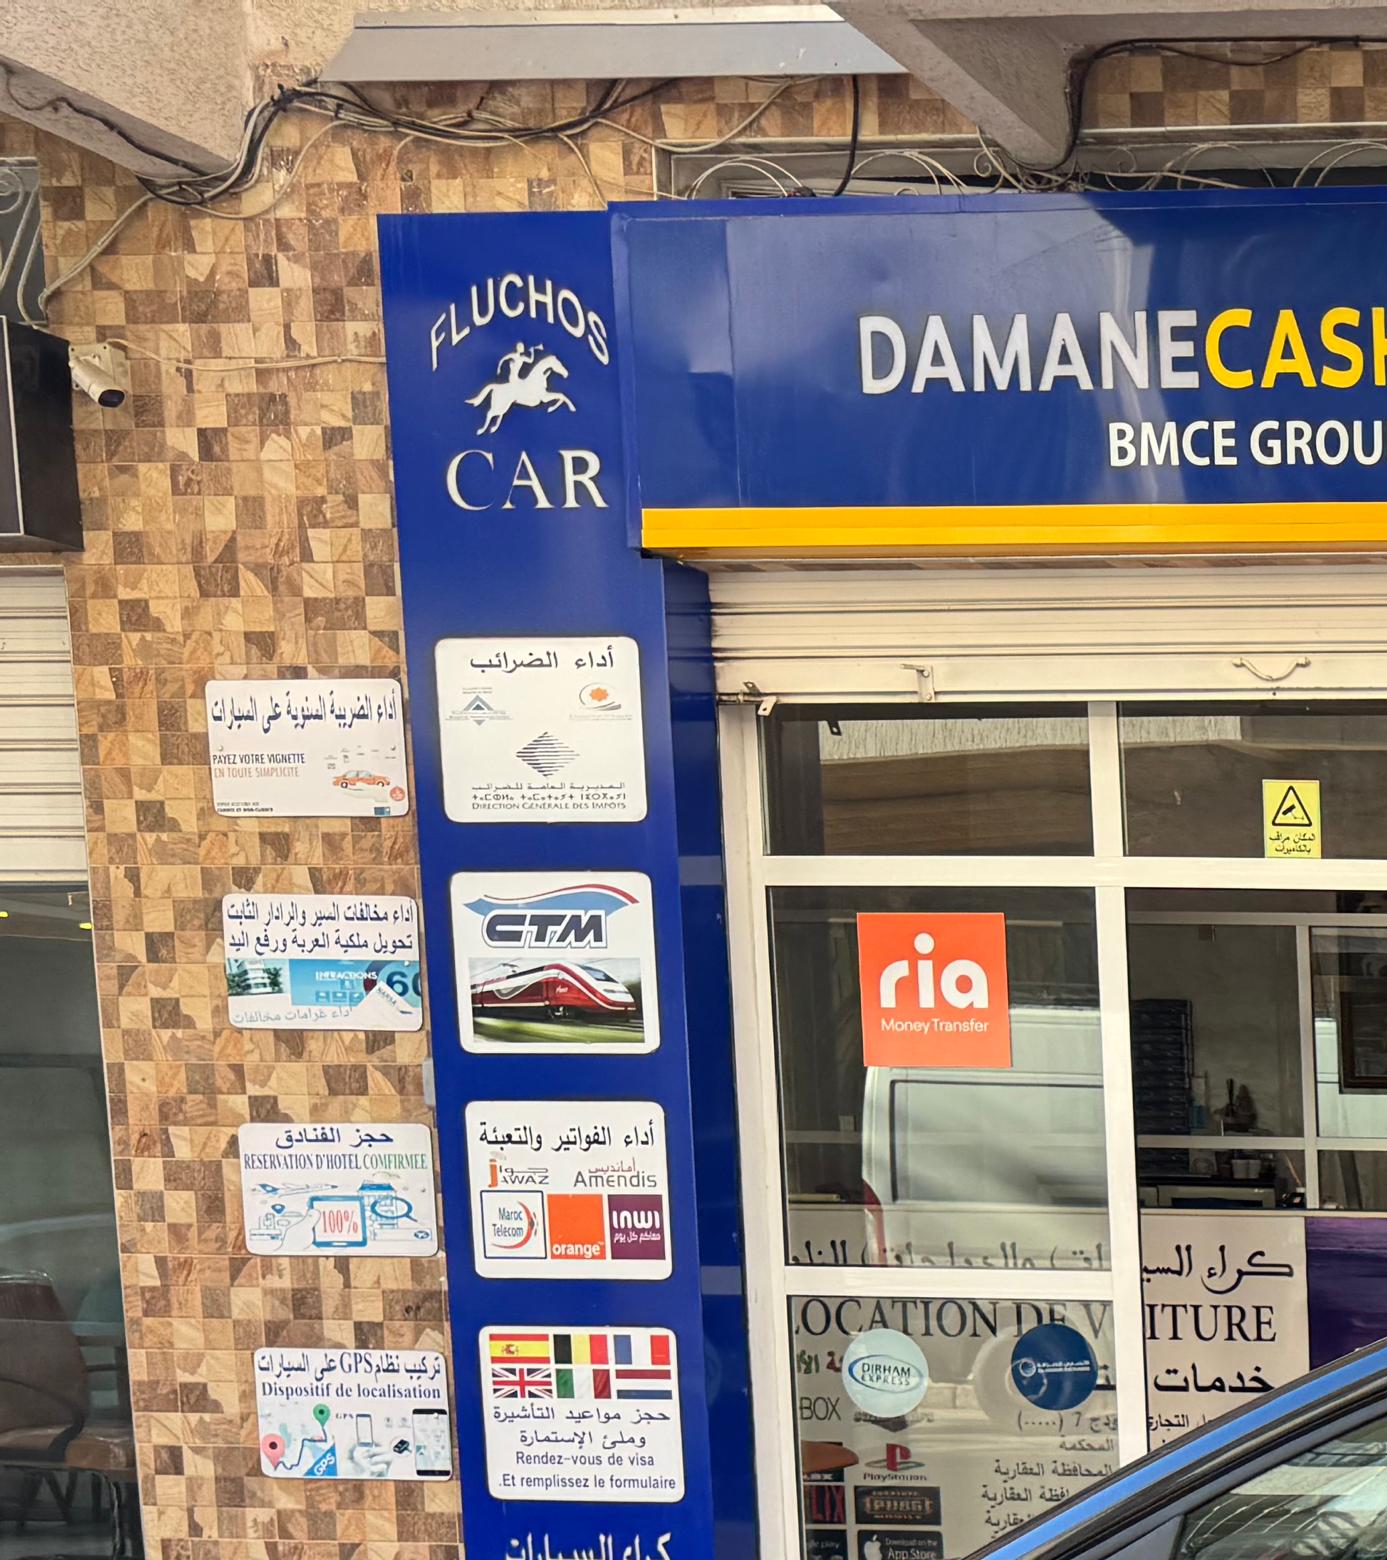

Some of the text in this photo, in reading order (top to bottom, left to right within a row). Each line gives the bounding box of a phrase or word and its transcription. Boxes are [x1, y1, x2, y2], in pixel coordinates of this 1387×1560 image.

[429, 273, 611, 372] FLUCHOS
[1107, 421, 1238, 468] BMCE
[445, 449, 609, 512] CAR
[470, 644, 614, 674] أداء الضرائب
[211, 696, 258, 731] السيارات
[285, 690, 327, 730] السنوية
[329, 690, 373, 729] الضريبة
[376, 687, 397, 724] أداء
[212, 753, 306, 765] PAYEZ VOTRE VIGNETTE
[227, 767, 253, 778] TOUTE
[472, 802, 520, 810] DIRECTION
[227, 898, 414, 927] أداء مخالفات السير والرادار الثابت
[484, 912, 606, 946] CTM
[228, 928, 413, 956] تحويل ملكية العربة ورفع اليد
[880, 933, 989, 1009] ria
[881, 1018, 989, 1034] Money Transfer
[275, 1126, 394, 1150] حجز الفنادق
[479, 1119, 655, 1152] أداء الفواتير والتعبئة
[244, 1153, 314, 1170] RESERVATION
[315, 1153, 362, 1170] D'HOTEL
[573, 1171, 657, 1188] Amendis
[322, 1209, 359, 1235] 100%
[498, 1207, 523, 1222] Maroc
[612, 1210, 661, 1230] inwi
[492, 1224, 524, 1238] Telecom
[552, 1242, 600, 1258] orange
[1200, 1244, 1294, 1295] كراء
[796, 1298, 998, 1338] OCATION
[258, 1351, 310, 1379] السيارات
[340, 1352, 373, 1374] GPS
[373, 1352, 400, 1382] نظام
[404, 1355, 441, 1381] تركيب
[861, 1362, 911, 1378] DIRHAM
[861, 1374, 910, 1386] EXPRESS
[1153, 1362, 1276, 1393] خدمات
[262, 1382, 441, 1400] Dispositif de localisation
[493, 1402, 671, 1425] حجز مواعيد التأشيرة
[519, 1430, 593, 1450] الإستمارة
[313, 1452, 336, 1476] GPS
[516, 1452, 655, 1467] Rendez-vous de visa
[520, 1474, 590, 1491] remplissez
[594, 1474, 605, 1488] le
[609, 1475, 676, 1490] formulaire
[910, 1548, 937, 1560] Store
